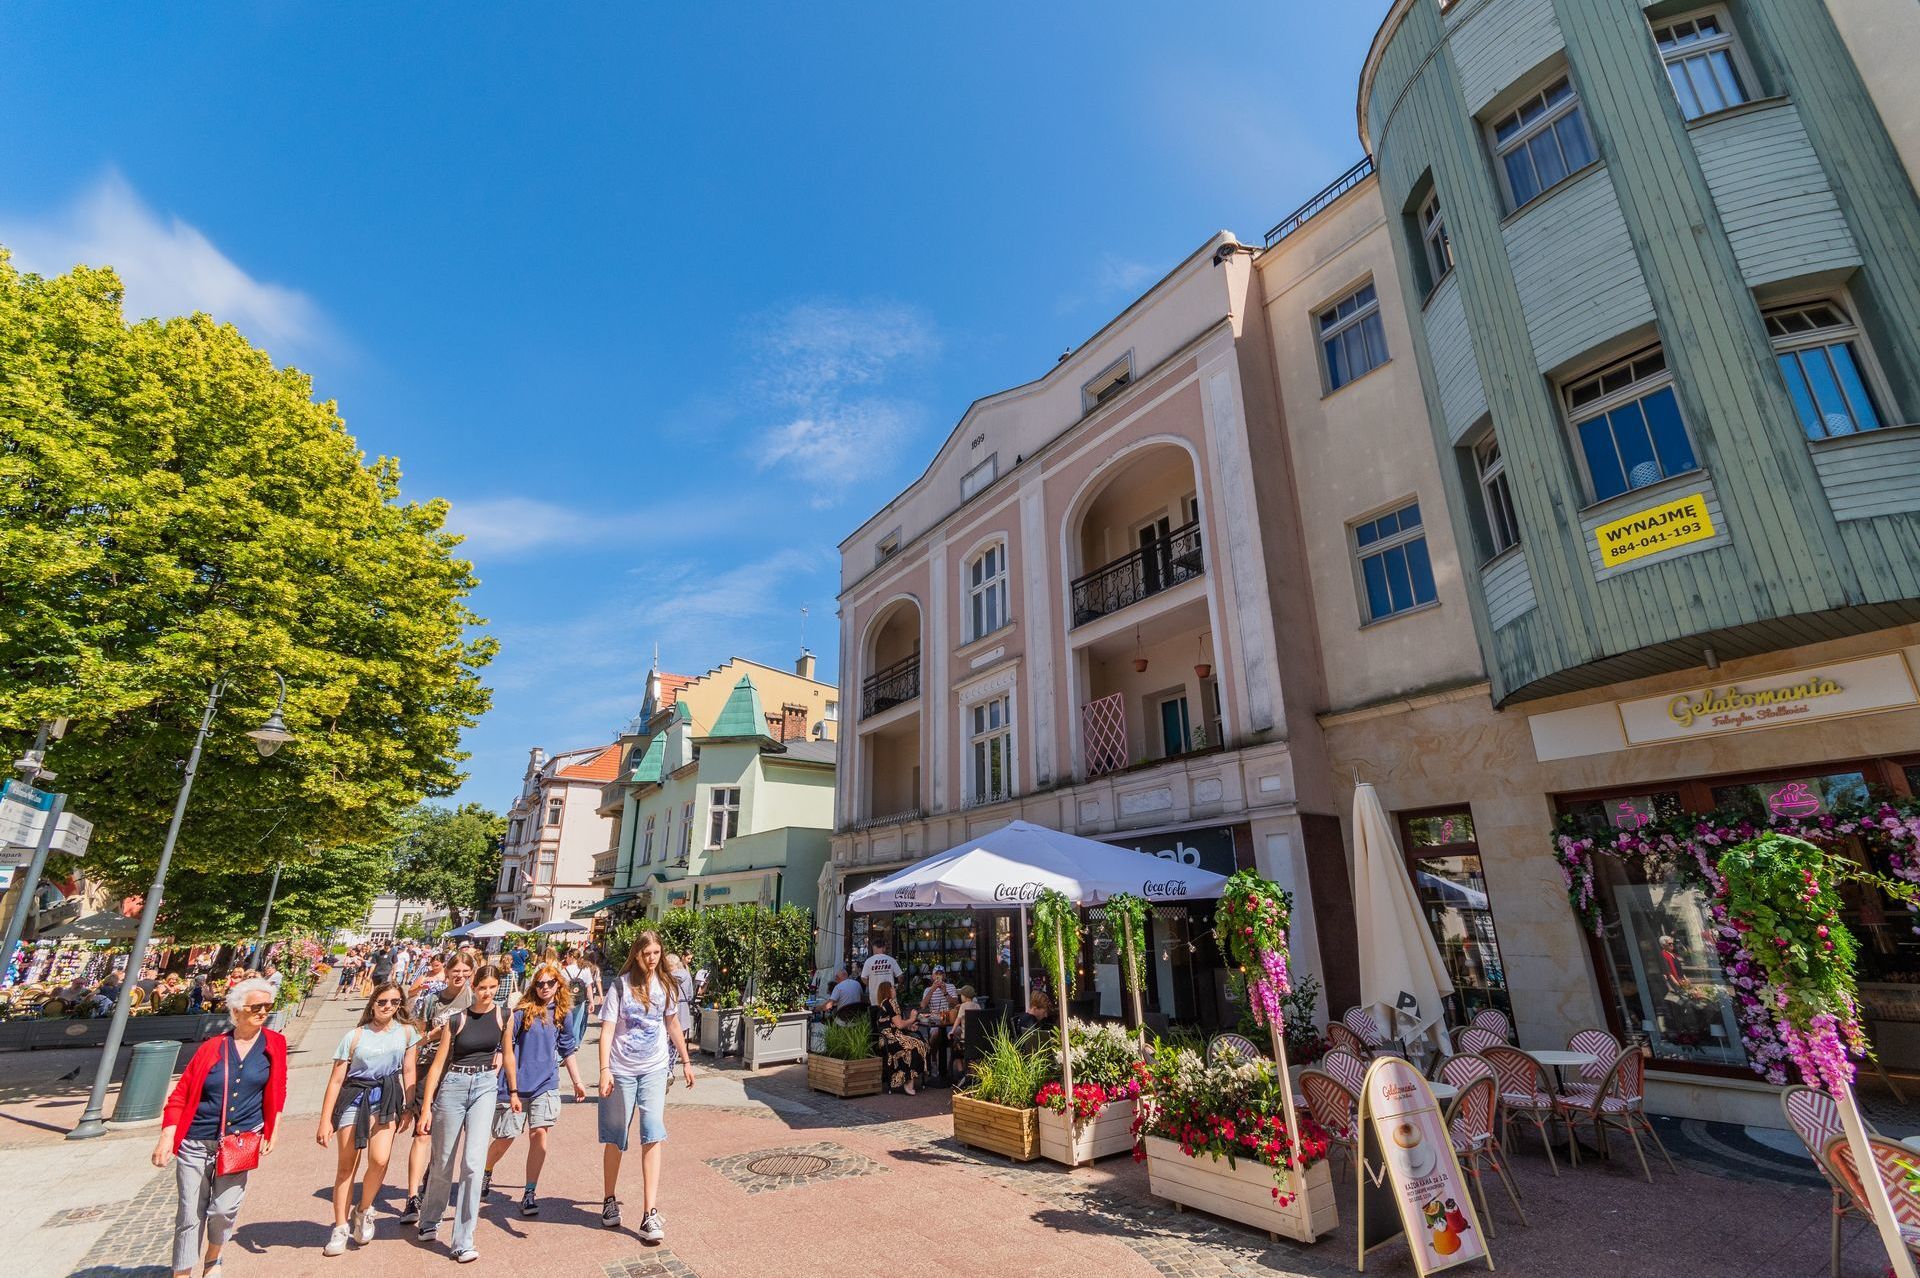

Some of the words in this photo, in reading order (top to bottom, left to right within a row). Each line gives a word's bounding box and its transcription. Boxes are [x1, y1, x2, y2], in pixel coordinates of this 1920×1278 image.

[1606, 504, 1698, 542] WYNAJMĘ
[1610, 522, 1701, 557] 884-041-193
[1668, 676, 1842, 727] Gelatomania
[1712, 712, 1755, 727] Fabryka
[1143, 880, 1187, 897] Coca-Cola
